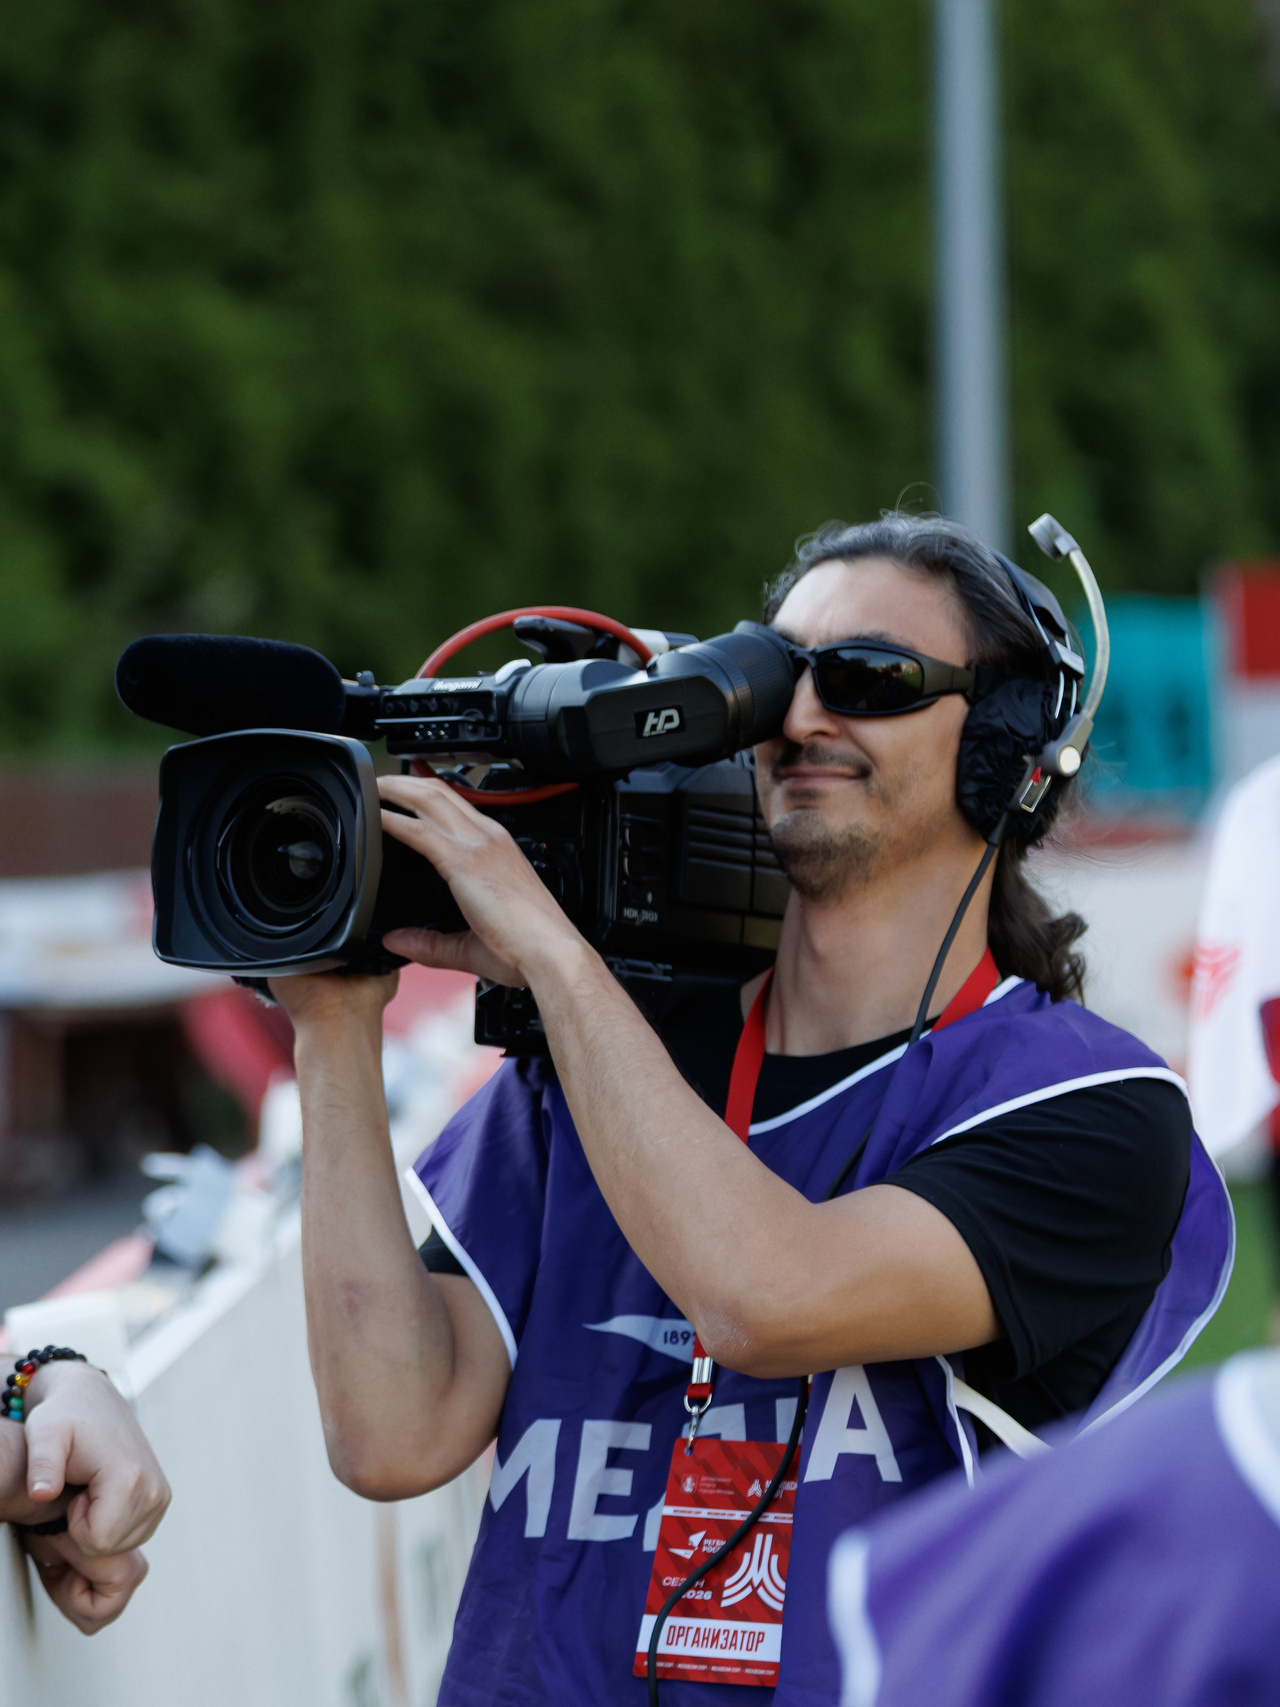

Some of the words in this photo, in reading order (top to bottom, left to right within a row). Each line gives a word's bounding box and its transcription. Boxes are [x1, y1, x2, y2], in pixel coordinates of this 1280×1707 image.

[643, 708, 680, 735] HD
[489, 1364, 903, 1553] МЕА
[665, 1624, 766, 1653] ОРГАНИЗАТОР
